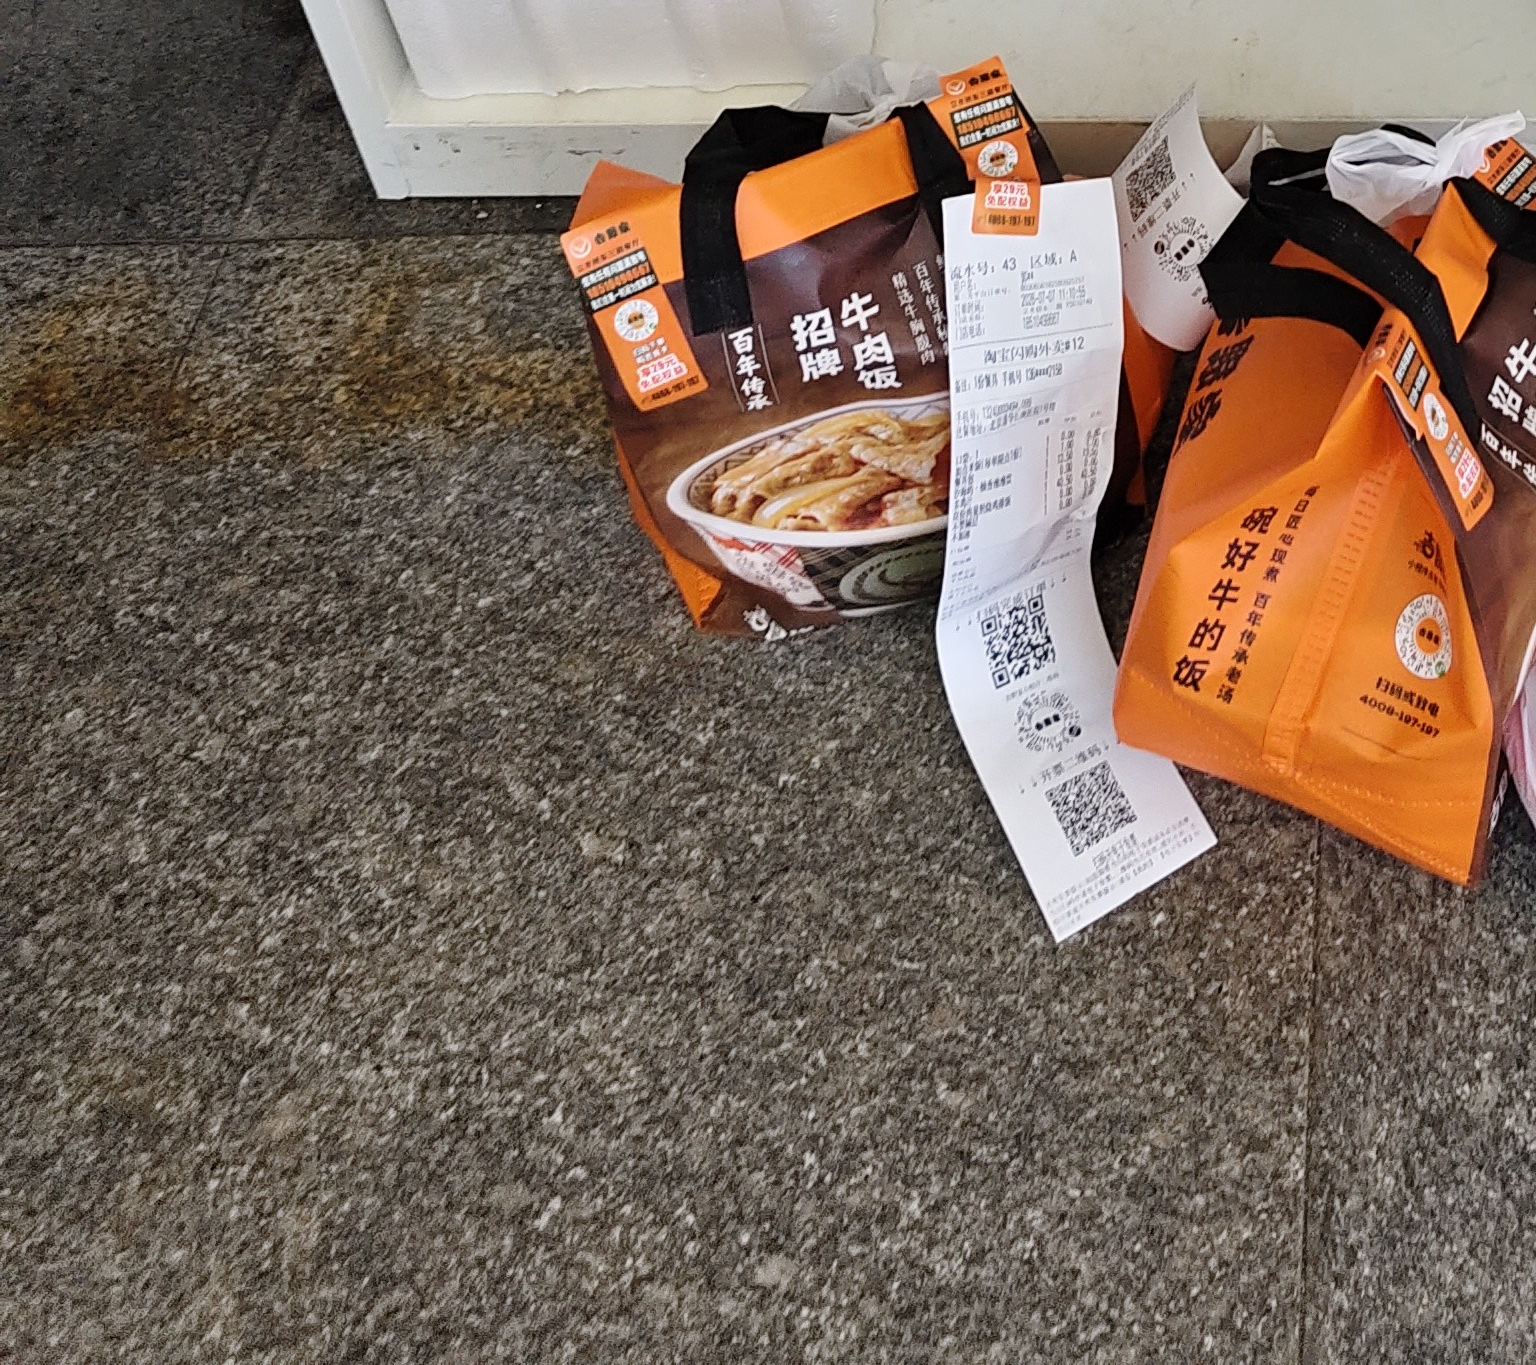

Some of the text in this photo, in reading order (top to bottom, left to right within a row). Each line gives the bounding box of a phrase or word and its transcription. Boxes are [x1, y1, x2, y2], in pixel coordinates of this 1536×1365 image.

[1002, 258, 1017, 270] 43
[1070, 250, 1077, 262] A
[728, 327, 773, 411] 百年传承
[790, 292, 902, 389] 招牌 牛肉饭
[1172, 506, 1279, 693] 碗好牛的饭
[1216, 484, 1321, 705] 每日匠心现煮 百年传承老汤
[1359, 694, 1441, 738] 4008-197-197
[1376, 676, 1441, 719] 扫码或致电
